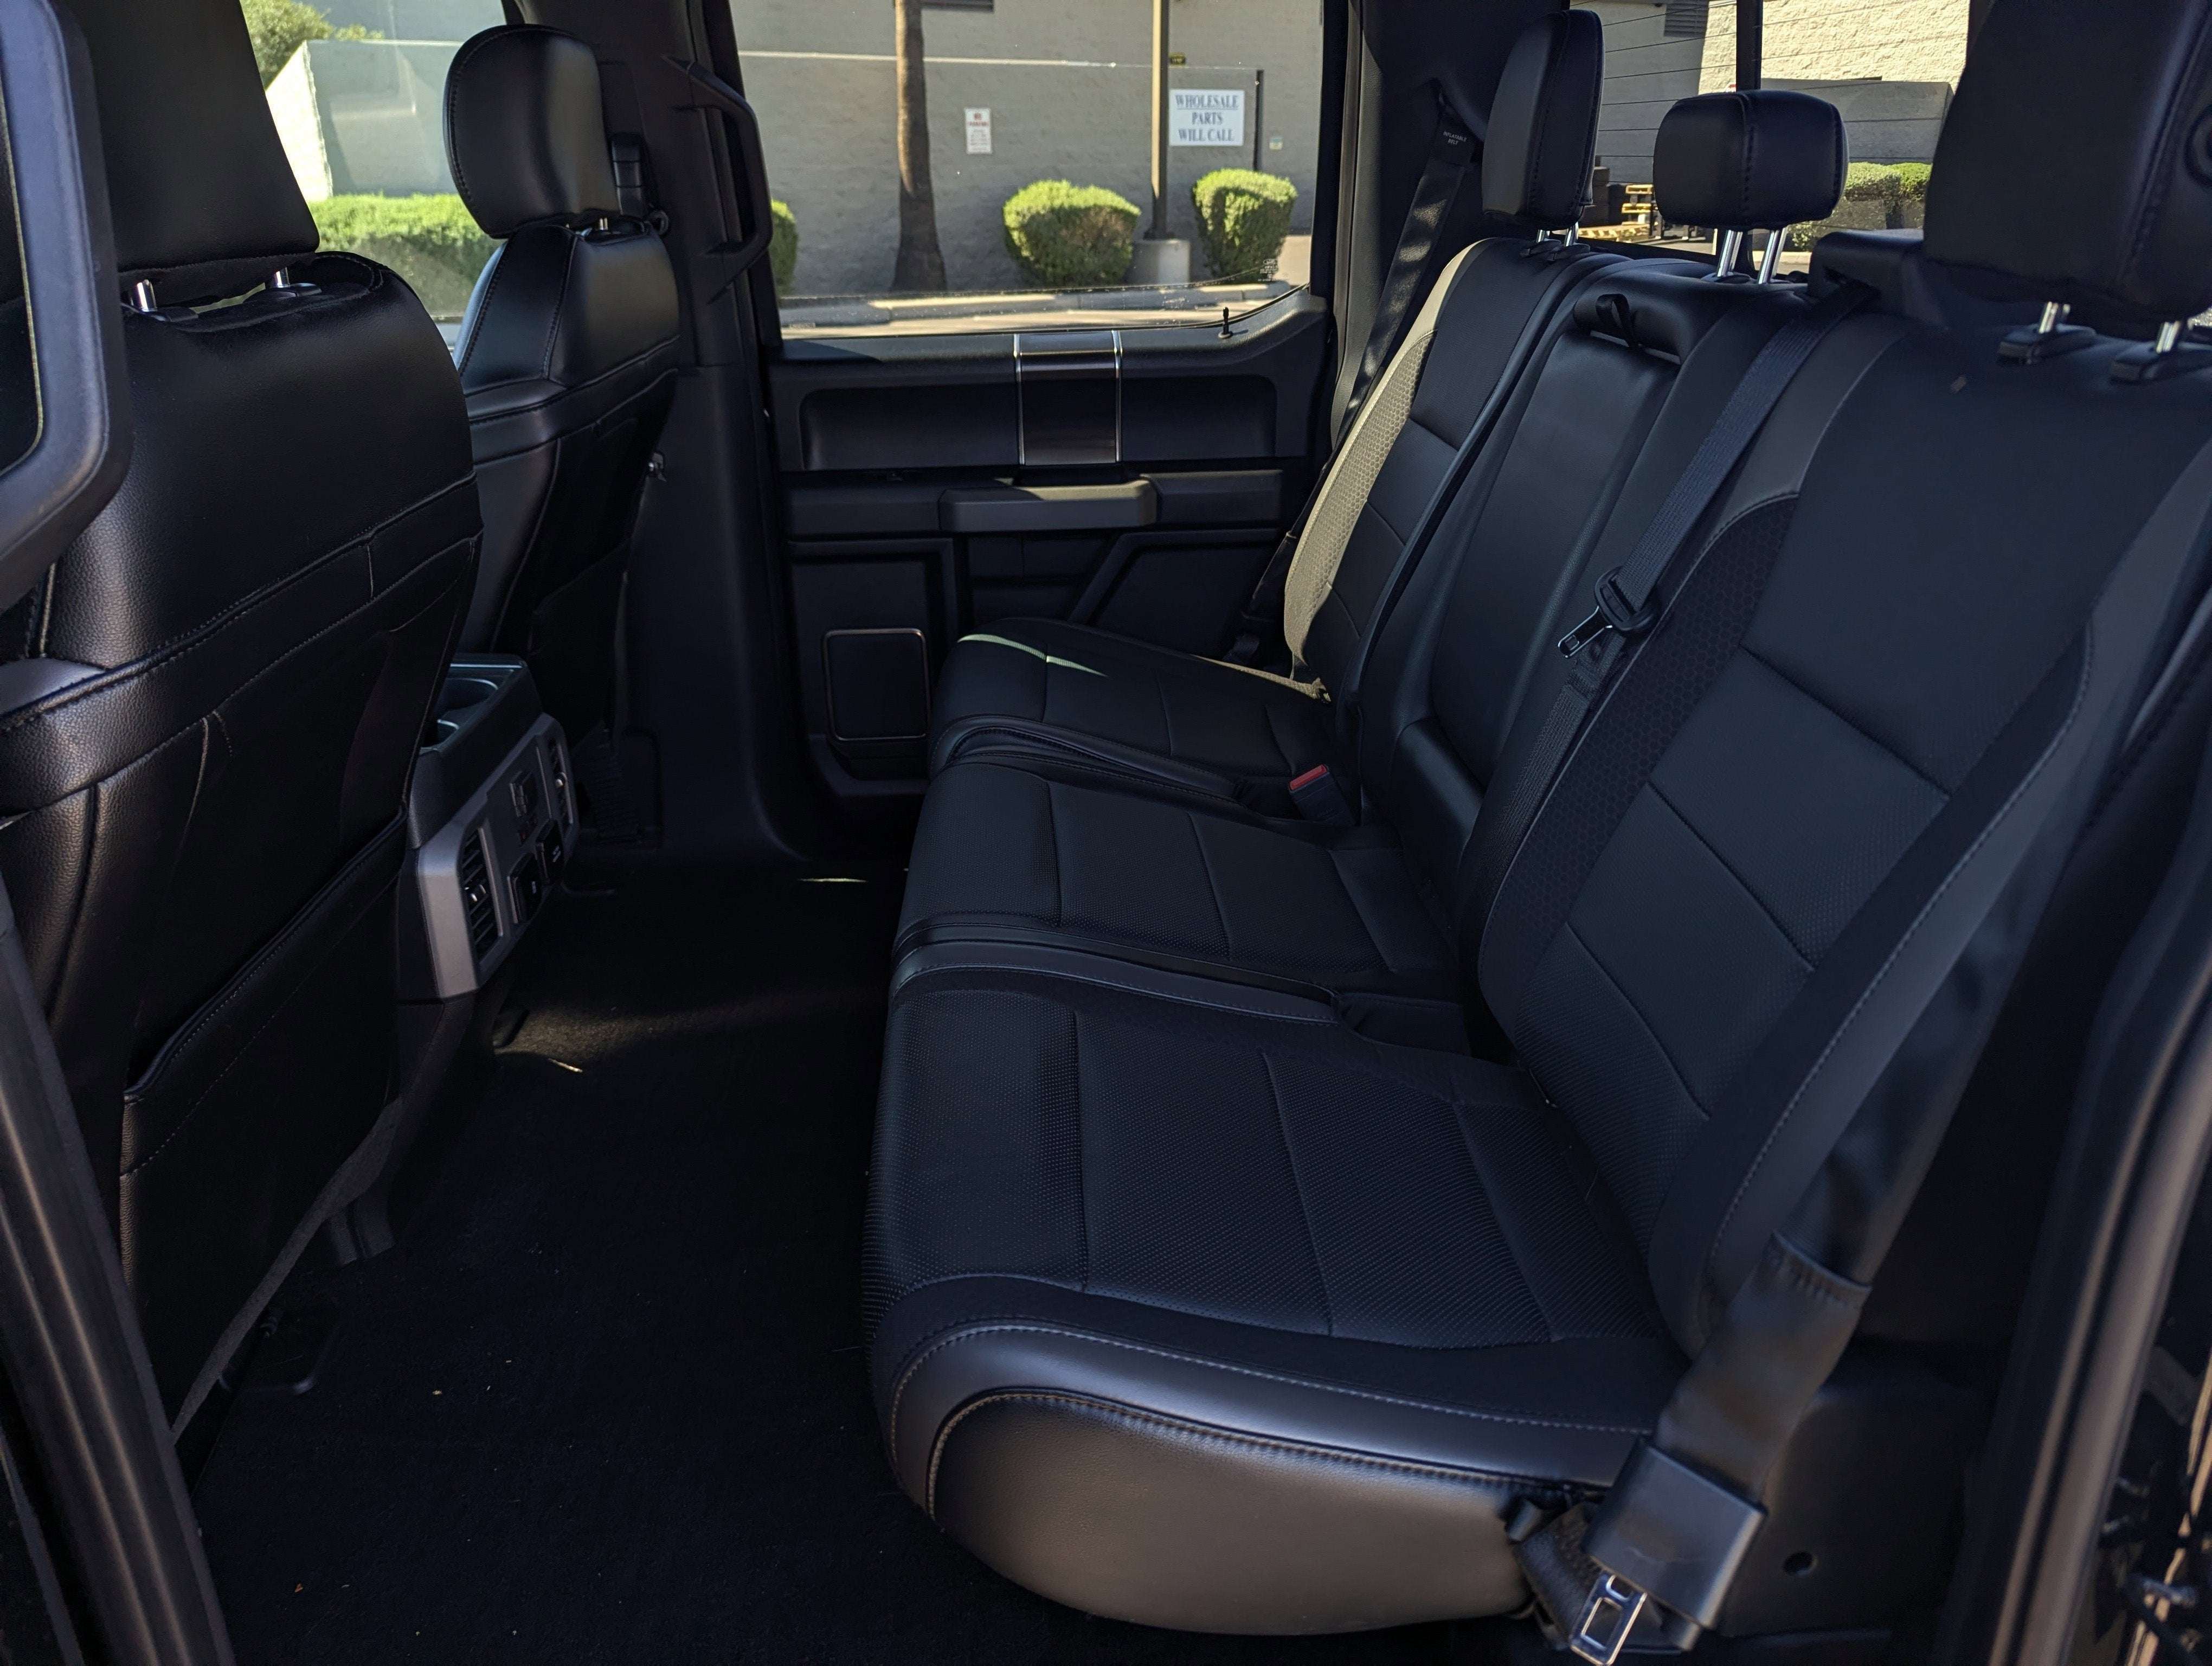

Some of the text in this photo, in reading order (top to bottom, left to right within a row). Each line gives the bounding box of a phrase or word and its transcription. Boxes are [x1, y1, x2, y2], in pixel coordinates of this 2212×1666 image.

[1175, 94, 1239, 109] WHOLESALE
[1192, 112, 1223, 125] PARTS
[1178, 129, 1234, 142] WILL CALL
